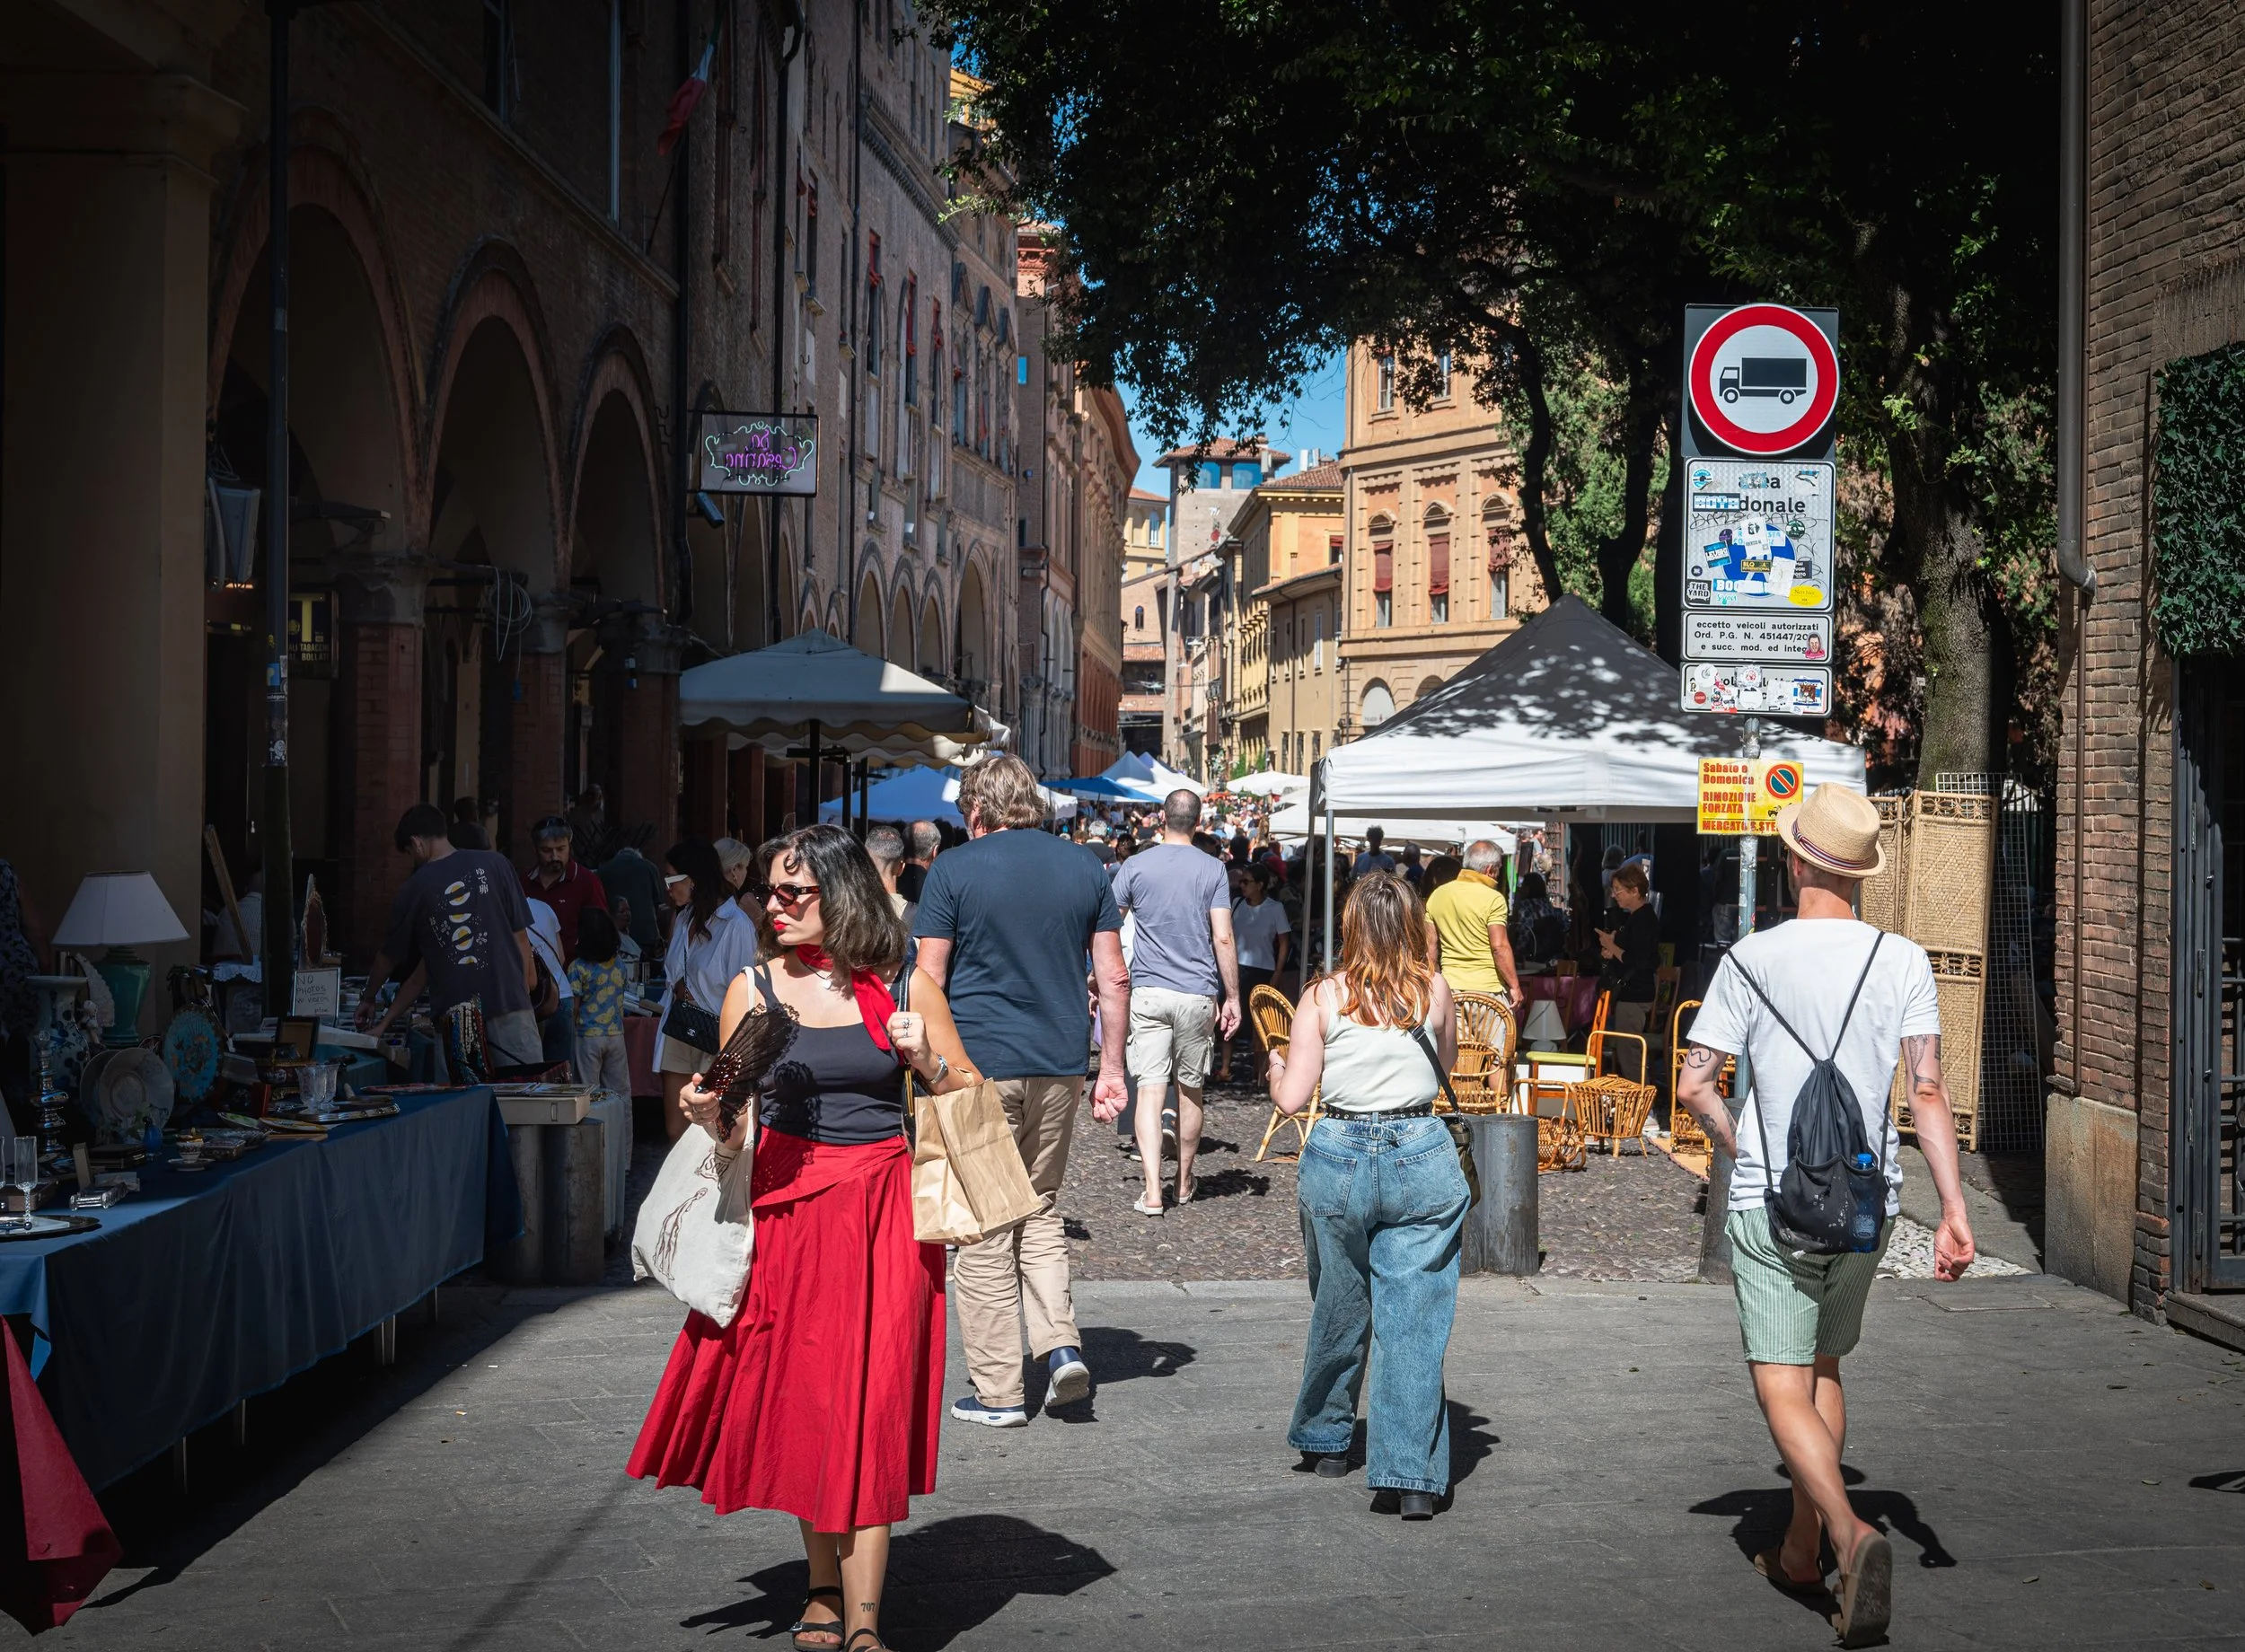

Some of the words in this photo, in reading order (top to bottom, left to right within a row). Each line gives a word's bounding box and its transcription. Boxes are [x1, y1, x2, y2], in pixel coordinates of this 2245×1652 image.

[1739, 496, 1806, 513] donale
[1687, 589, 1709, 597] YARD
[1736, 621, 1766, 630] veicoli
[1771, 622, 1819, 631] autorizzati
[1694, 631, 1713, 639] Ord.
[1743, 632, 1754, 640] N.
[1759, 632, 1808, 643] 451447/20
[1740, 644, 1763, 652] mod.
[1767, 644, 1779, 652] ed
[1783, 645, 1808, 655] integ
[1703, 762, 1739, 773] Sabato
[1741, 764, 1748, 773] e
[1703, 774, 1755, 785] Domenica
[1703, 791, 1756, 803] RIMOZIONE
[1702, 803, 1744, 813] FORZATA
[1702, 820, 1748, 831] MERCATO
[1750, 821, 1779, 831] S.STE
[476, 867, 489, 895] ゆで卵
[296, 973, 314, 984] NO
[295, 984, 327, 996] PHOTOS
[860, 1602, 876, 1612] 707
